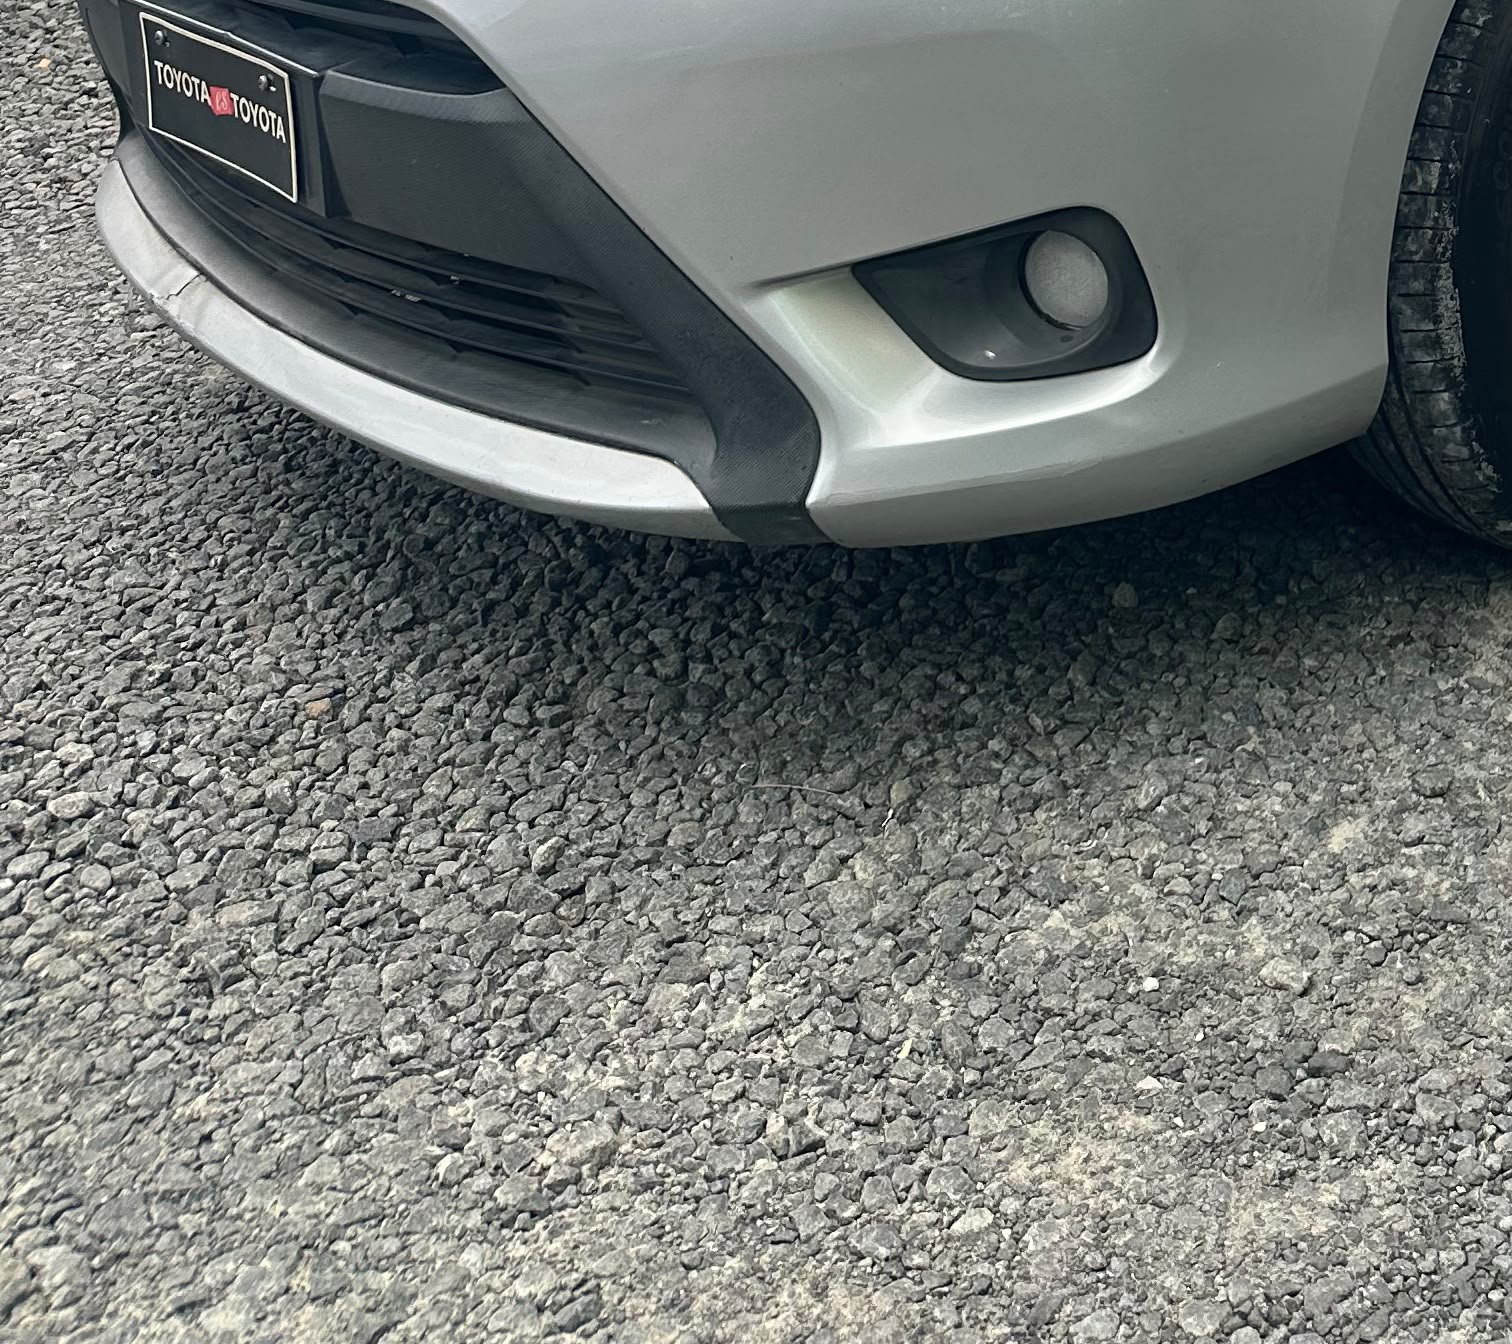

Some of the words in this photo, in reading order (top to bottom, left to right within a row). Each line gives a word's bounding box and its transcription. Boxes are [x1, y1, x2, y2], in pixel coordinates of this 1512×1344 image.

[154, 60, 212, 106] TOYOTA
[215, 92, 228, 111] es
[230, 92, 287, 144] TOYOTA
